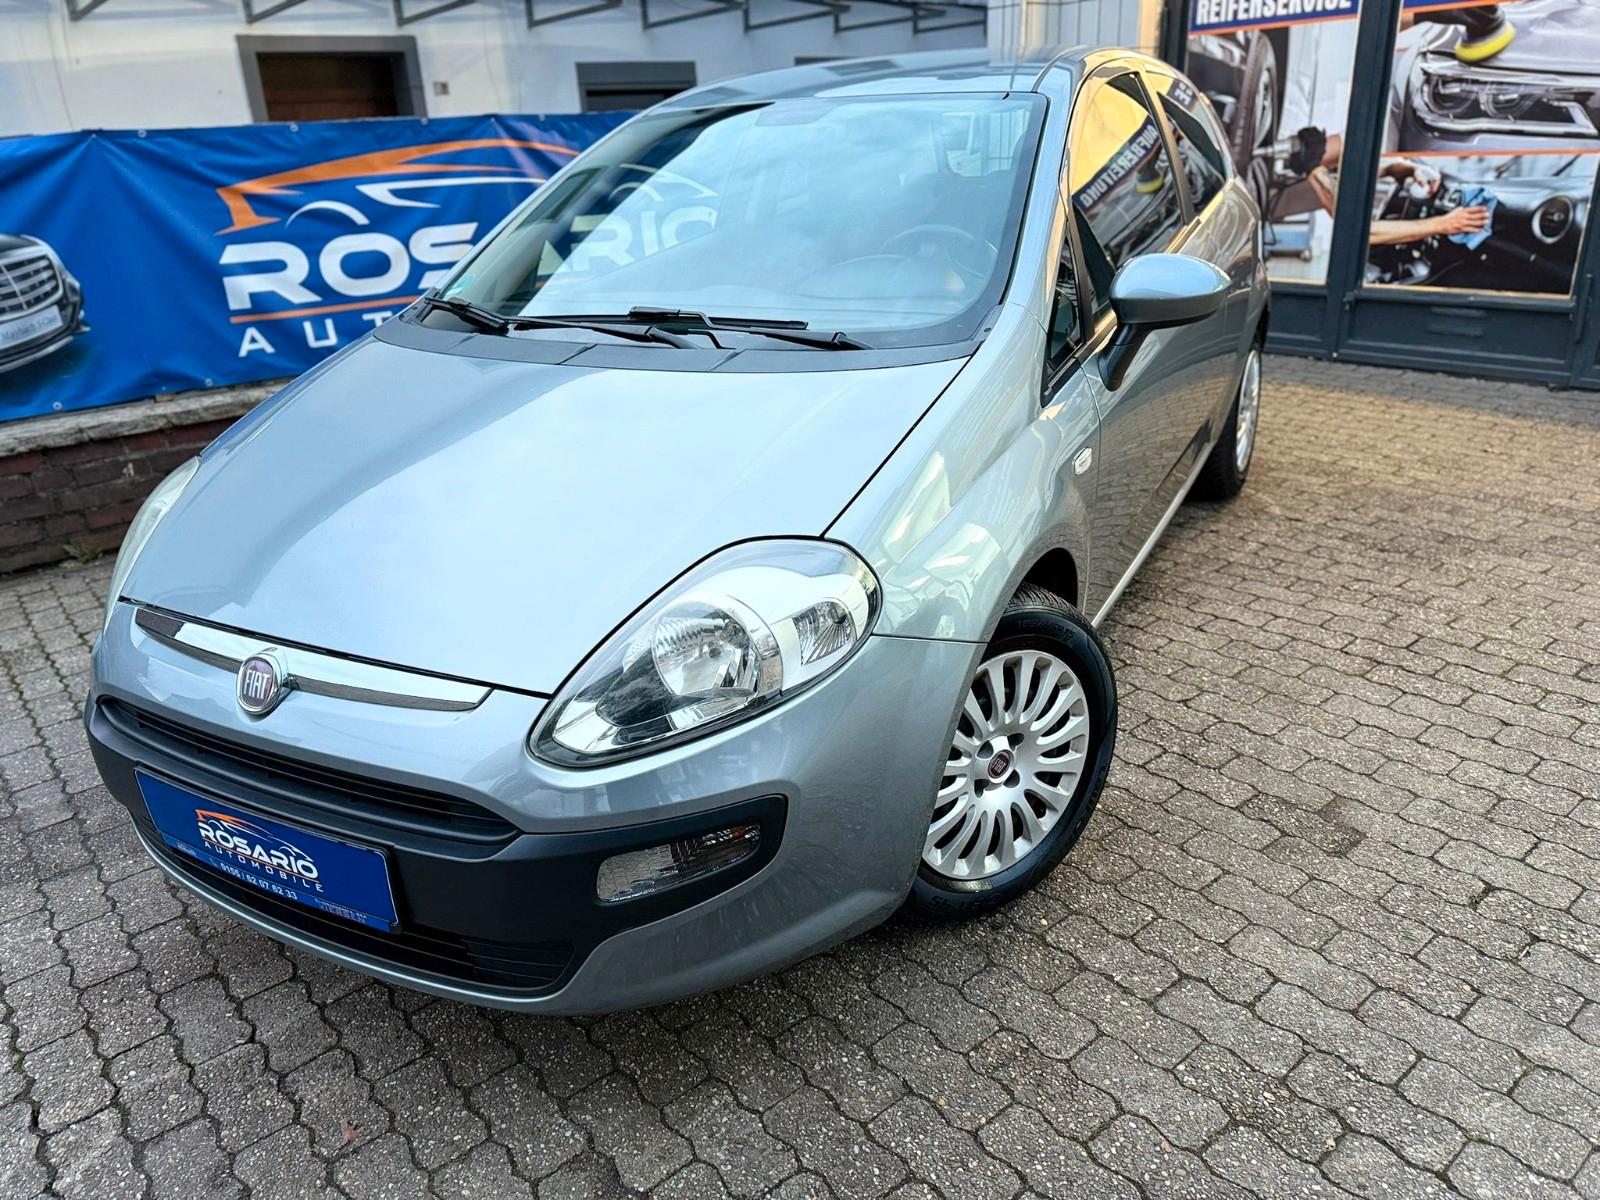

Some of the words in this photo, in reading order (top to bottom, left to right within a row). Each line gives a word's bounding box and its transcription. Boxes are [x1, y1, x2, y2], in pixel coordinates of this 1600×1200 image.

[1196, 0, 1353, 25] REIFENSER
[243, 669, 271, 700] FIAT
[198, 822, 319, 879] ROSARIO
[204, 841, 324, 893] AUTOMOBILE
[285, 889, 298, 900] 33
